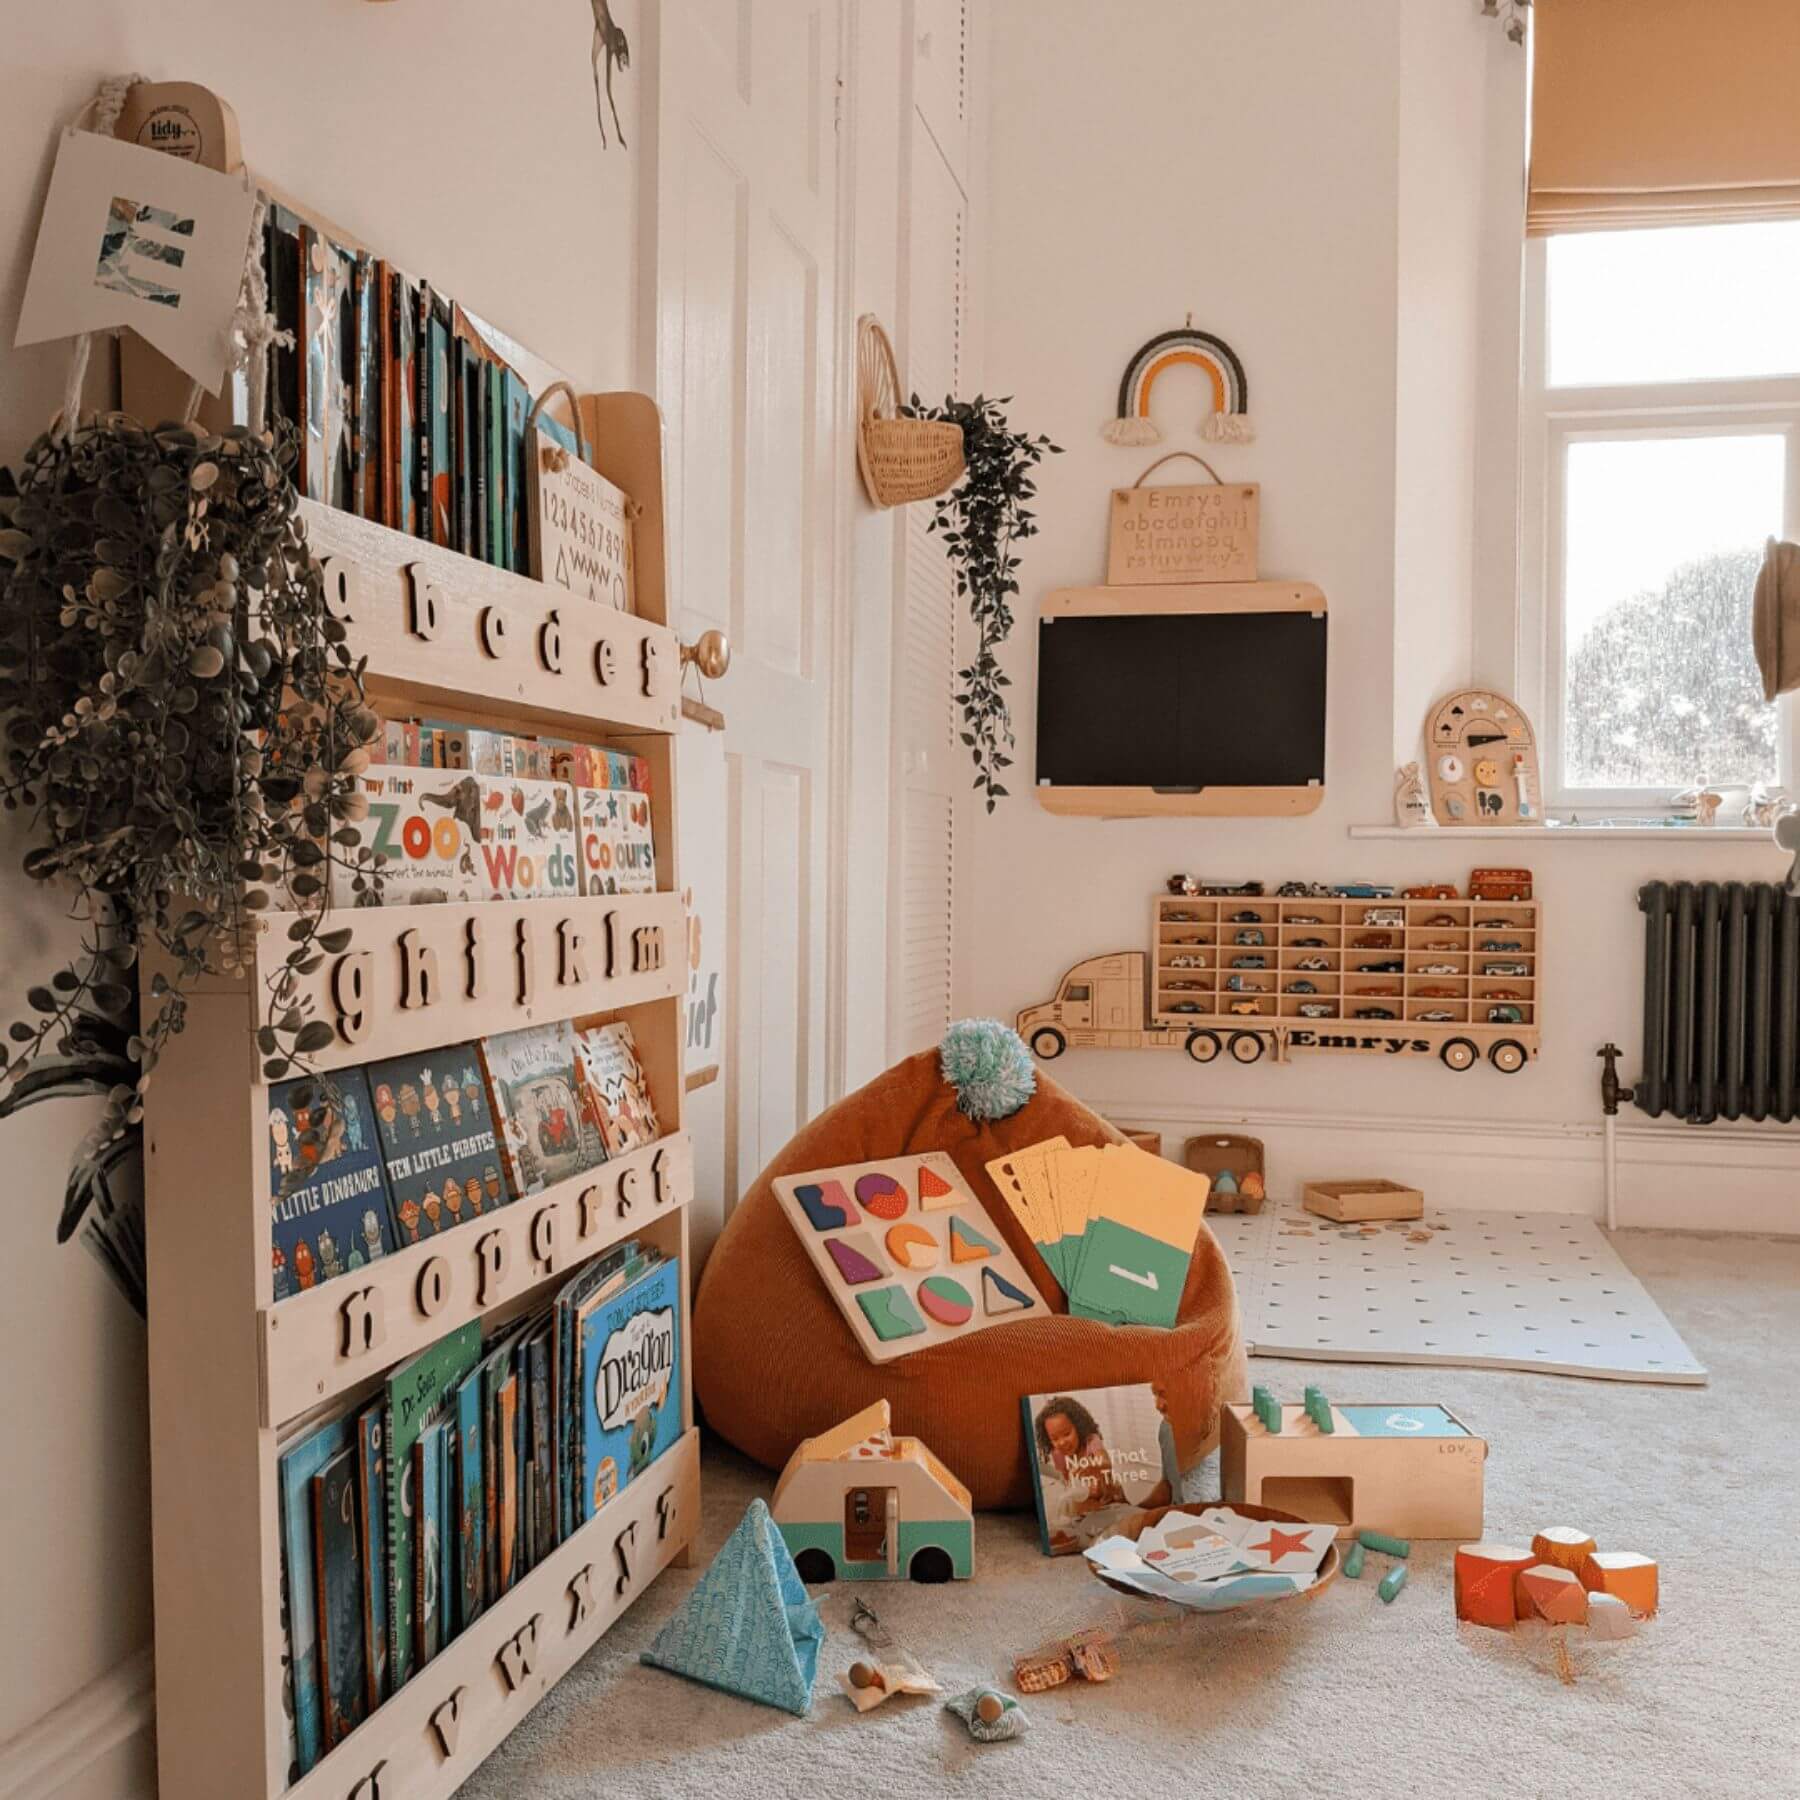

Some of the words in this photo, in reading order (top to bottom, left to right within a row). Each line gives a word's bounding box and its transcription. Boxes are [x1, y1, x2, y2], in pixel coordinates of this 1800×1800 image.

[94, 196, 195, 308] E
[481, 843, 577, 890] Words
[1290, 1030, 1431, 1055] Emrys
[386, 1160, 412, 1182] TEN
[413, 1144, 452, 1174] LITTLE
[451, 1130, 497, 1161] PIRATES
[281, 1185, 321, 1222] LITTLE
[321, 1165, 381, 1208] DINOSAURS
[601, 1327, 672, 1421] Dragon
[1065, 1453, 1104, 1471] Now
[1109, 1447, 1149, 1465] That
[1070, 1471, 1099, 1488] I'm
[1103, 1467, 1149, 1486] Three
